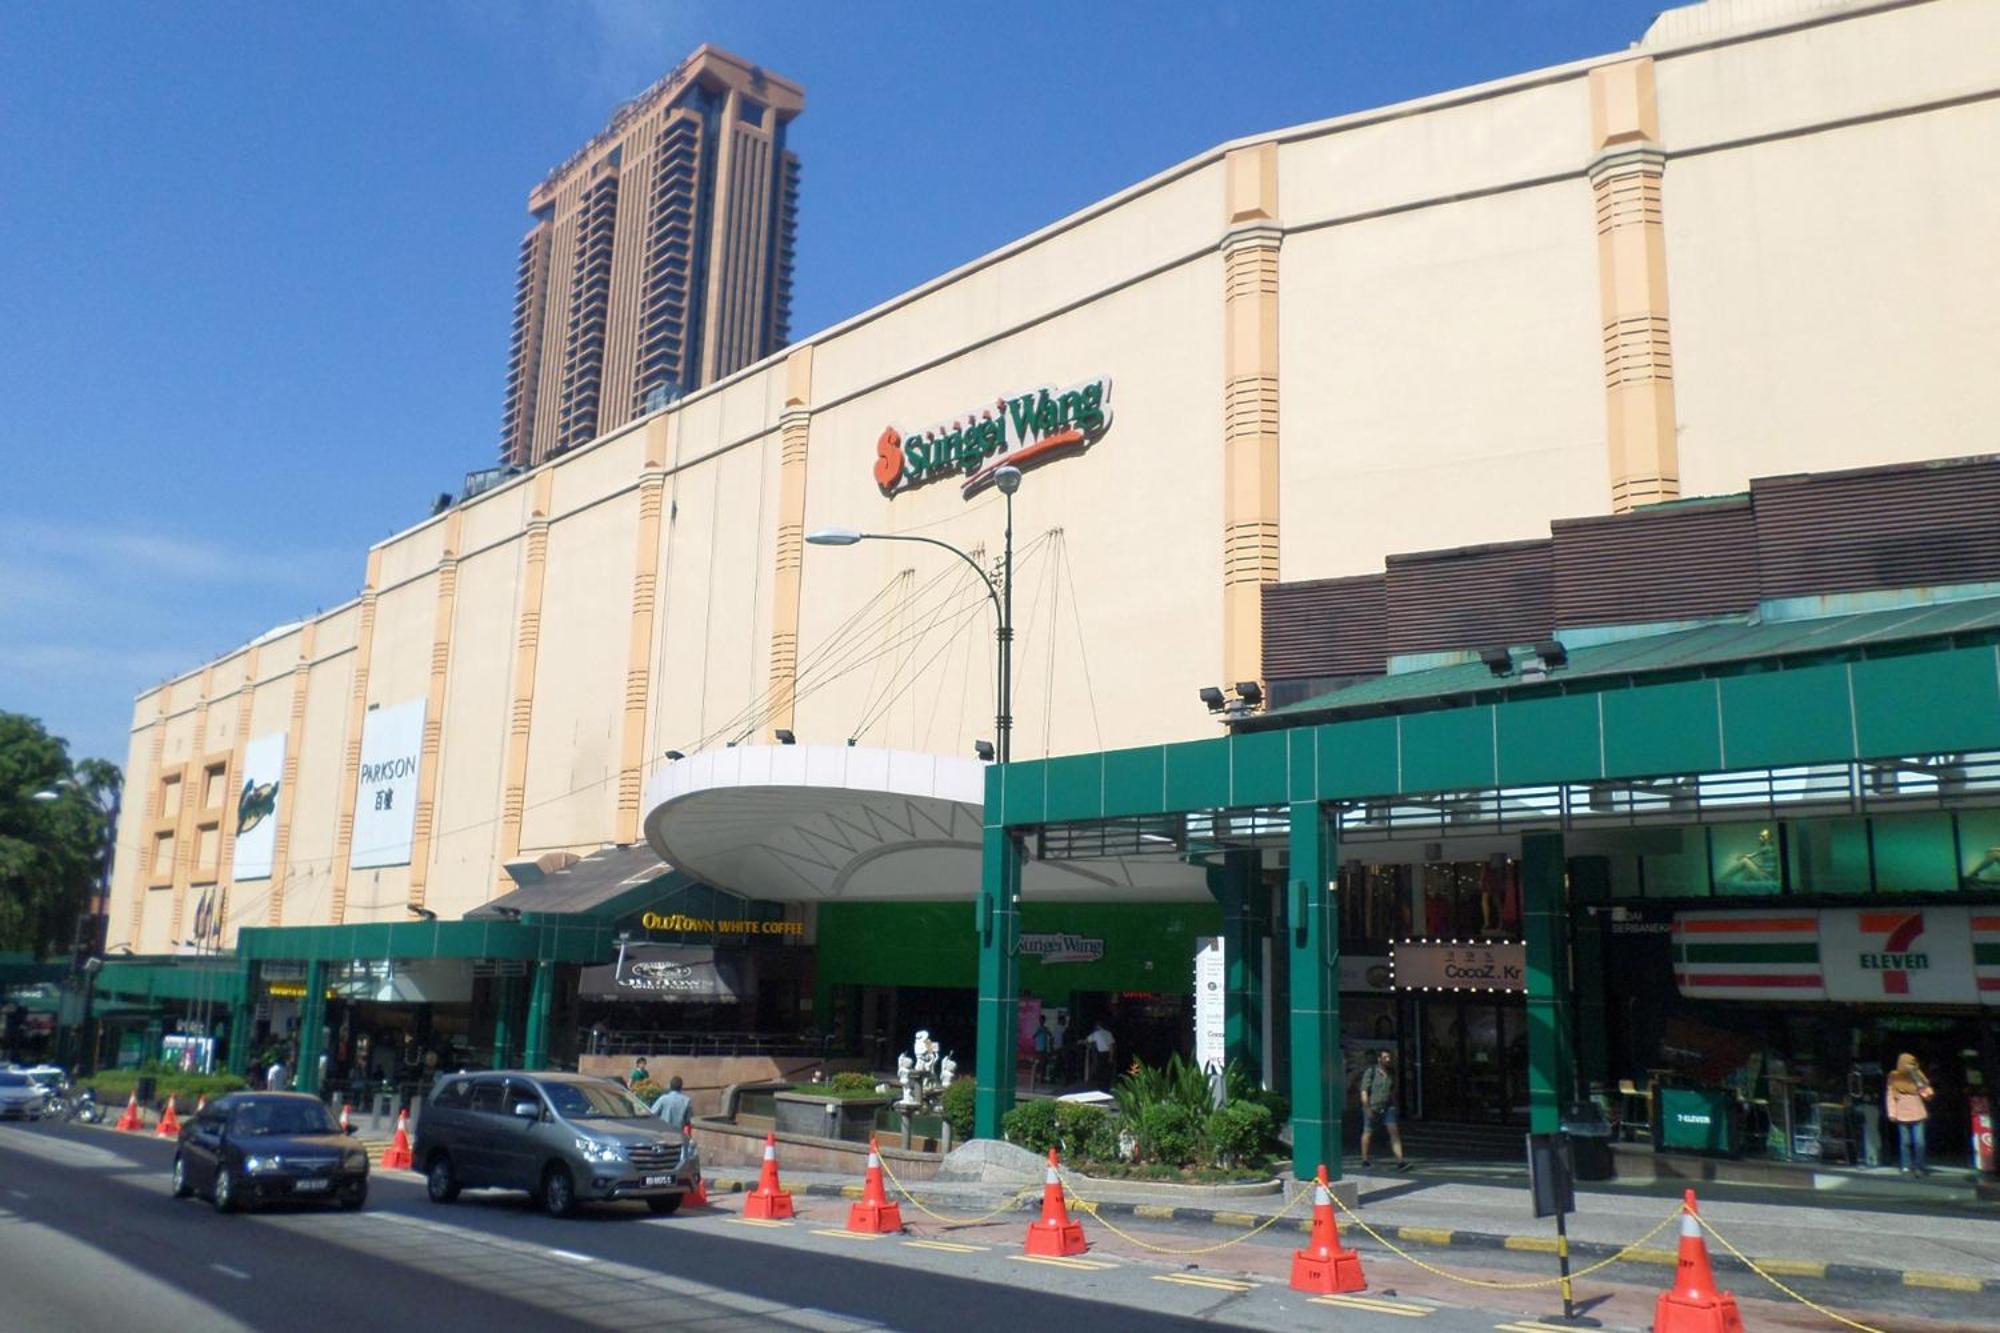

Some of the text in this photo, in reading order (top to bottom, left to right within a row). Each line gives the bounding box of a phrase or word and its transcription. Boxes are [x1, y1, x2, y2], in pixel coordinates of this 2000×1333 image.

[903, 380, 1104, 478] Sungei Wang
[361, 755, 416, 784] PARKSON
[717, 919, 760, 933] WHITE
[761, 921, 803, 935] COFFEE
[1859, 912, 1924, 994] 7
